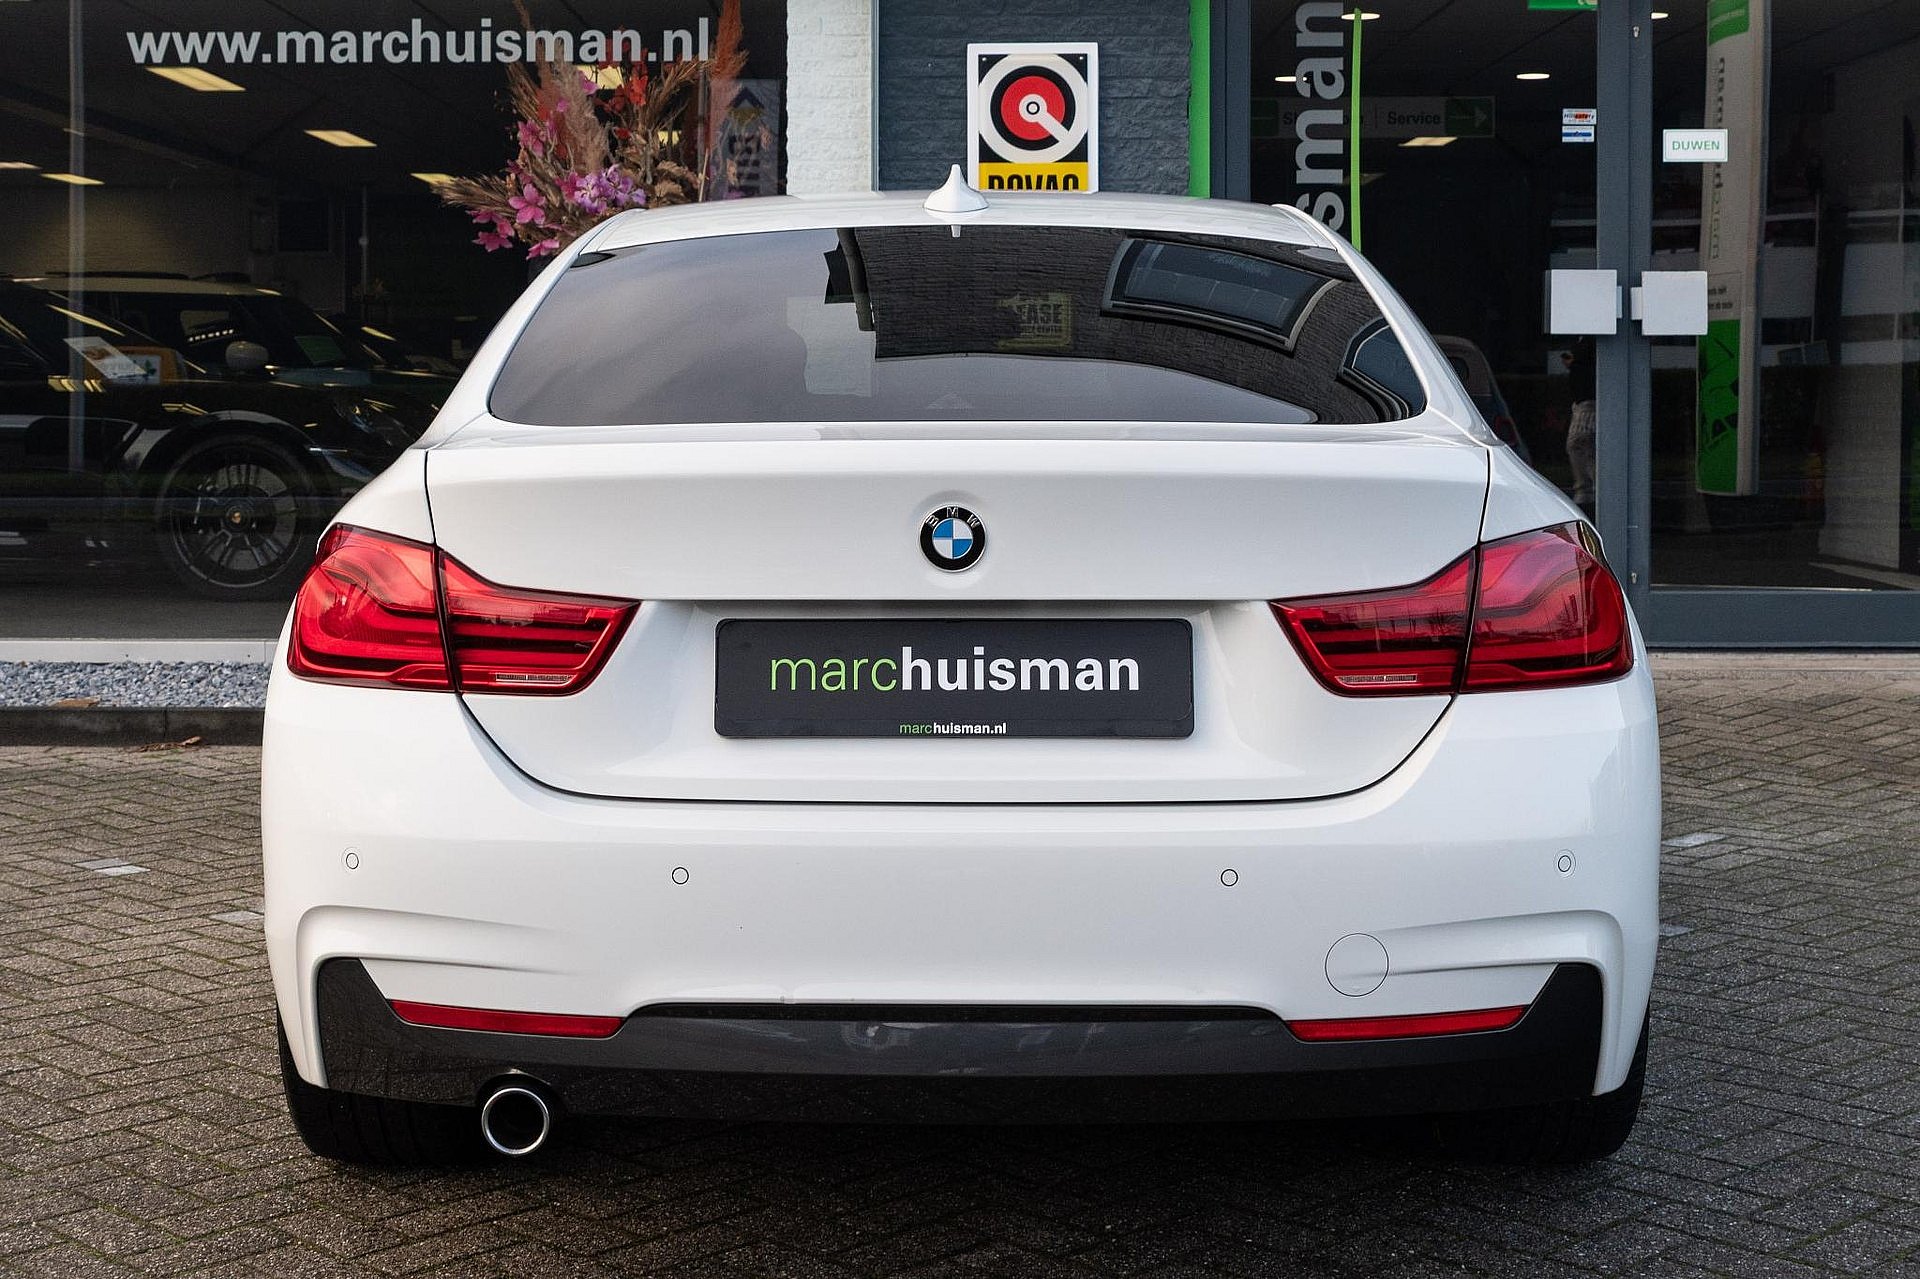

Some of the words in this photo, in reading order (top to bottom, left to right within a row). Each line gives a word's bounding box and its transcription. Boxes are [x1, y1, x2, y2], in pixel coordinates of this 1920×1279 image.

[126, 18, 710, 64] www.marchuisman.nl
[1387, 111, 1441, 125] Service
[1672, 140, 1720, 151] DUWEN
[925, 505, 981, 528] BMW
[770, 646, 1140, 692] marchuisman
[899, 721, 1007, 735] marchuisman.nl
